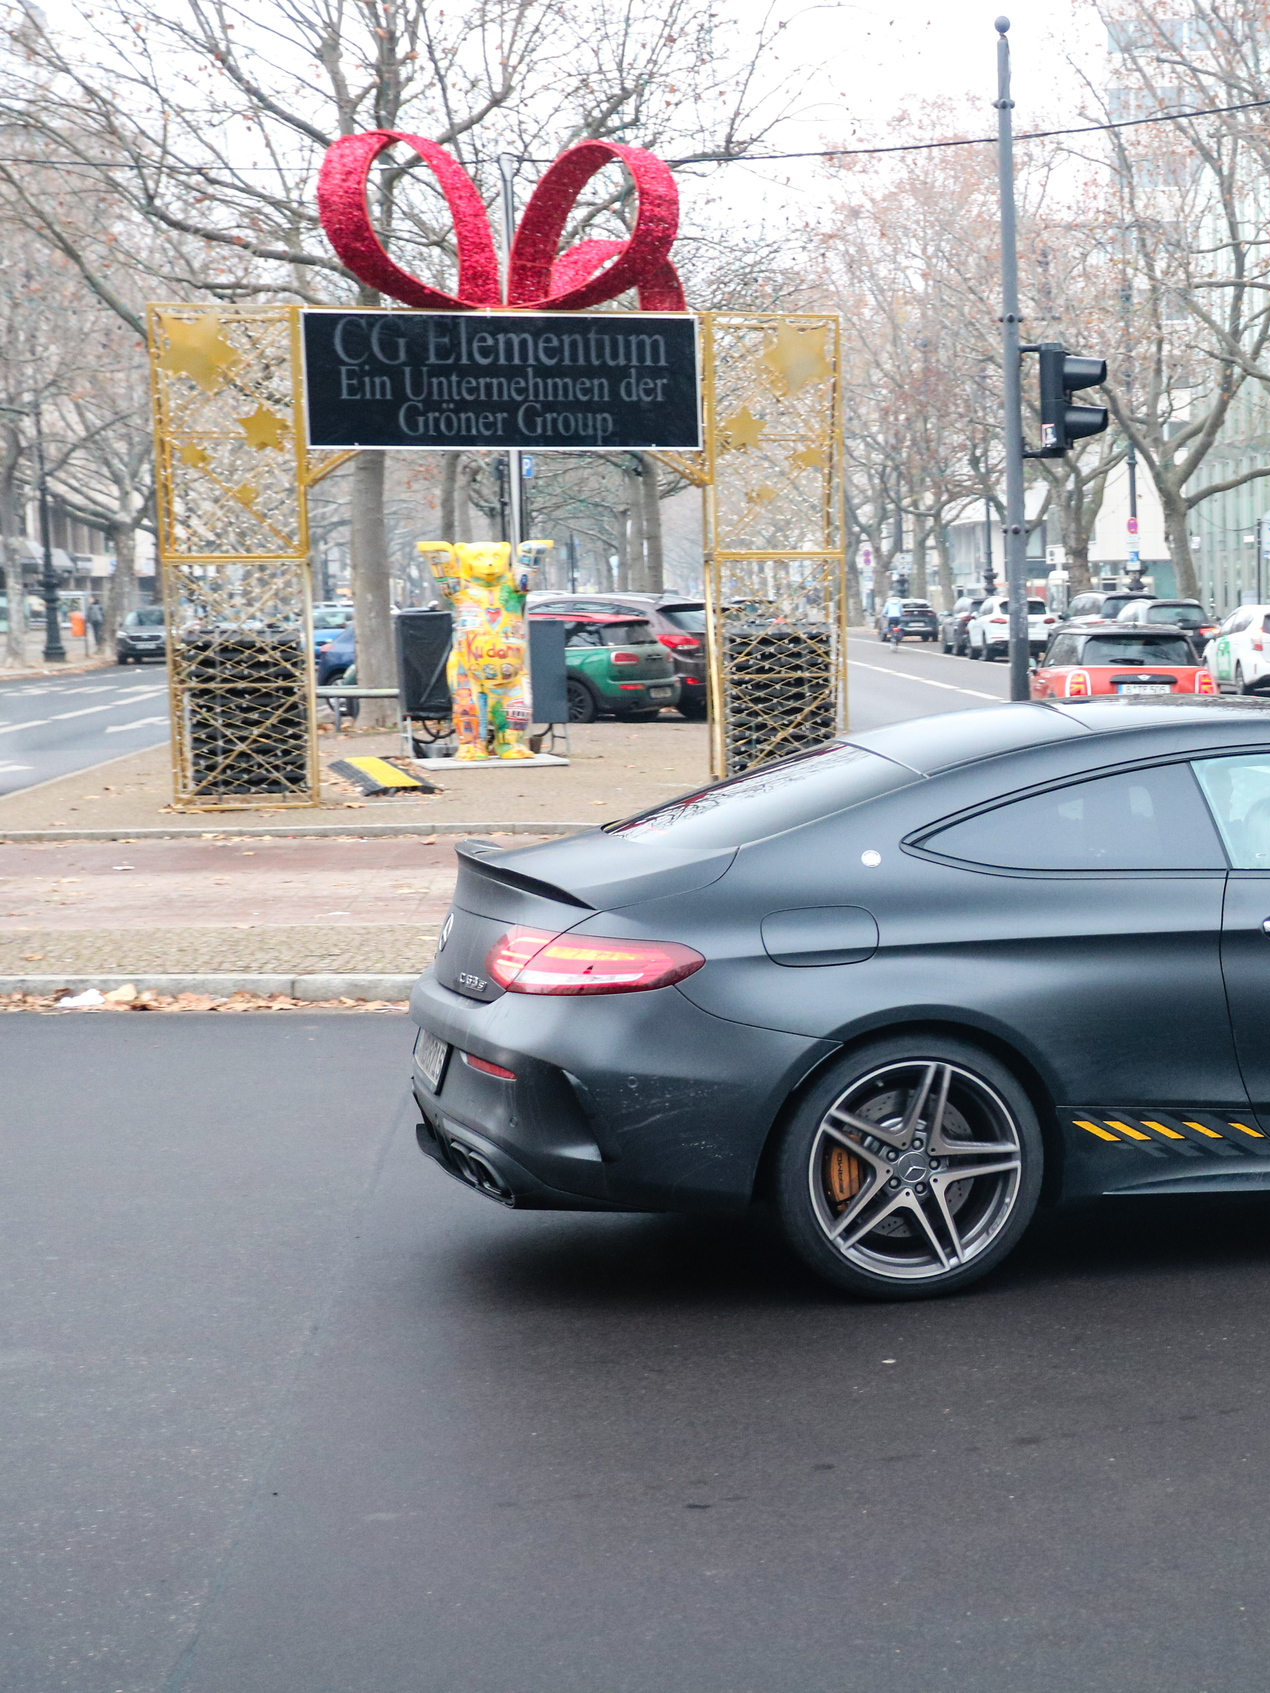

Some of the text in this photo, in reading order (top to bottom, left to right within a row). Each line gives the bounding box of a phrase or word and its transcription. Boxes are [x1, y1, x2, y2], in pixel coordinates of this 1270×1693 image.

[333, 316, 669, 367] CG Elementum
[338, 365, 668, 402] Ein Unternehmen der
[398, 401, 614, 438] Gröner Group
